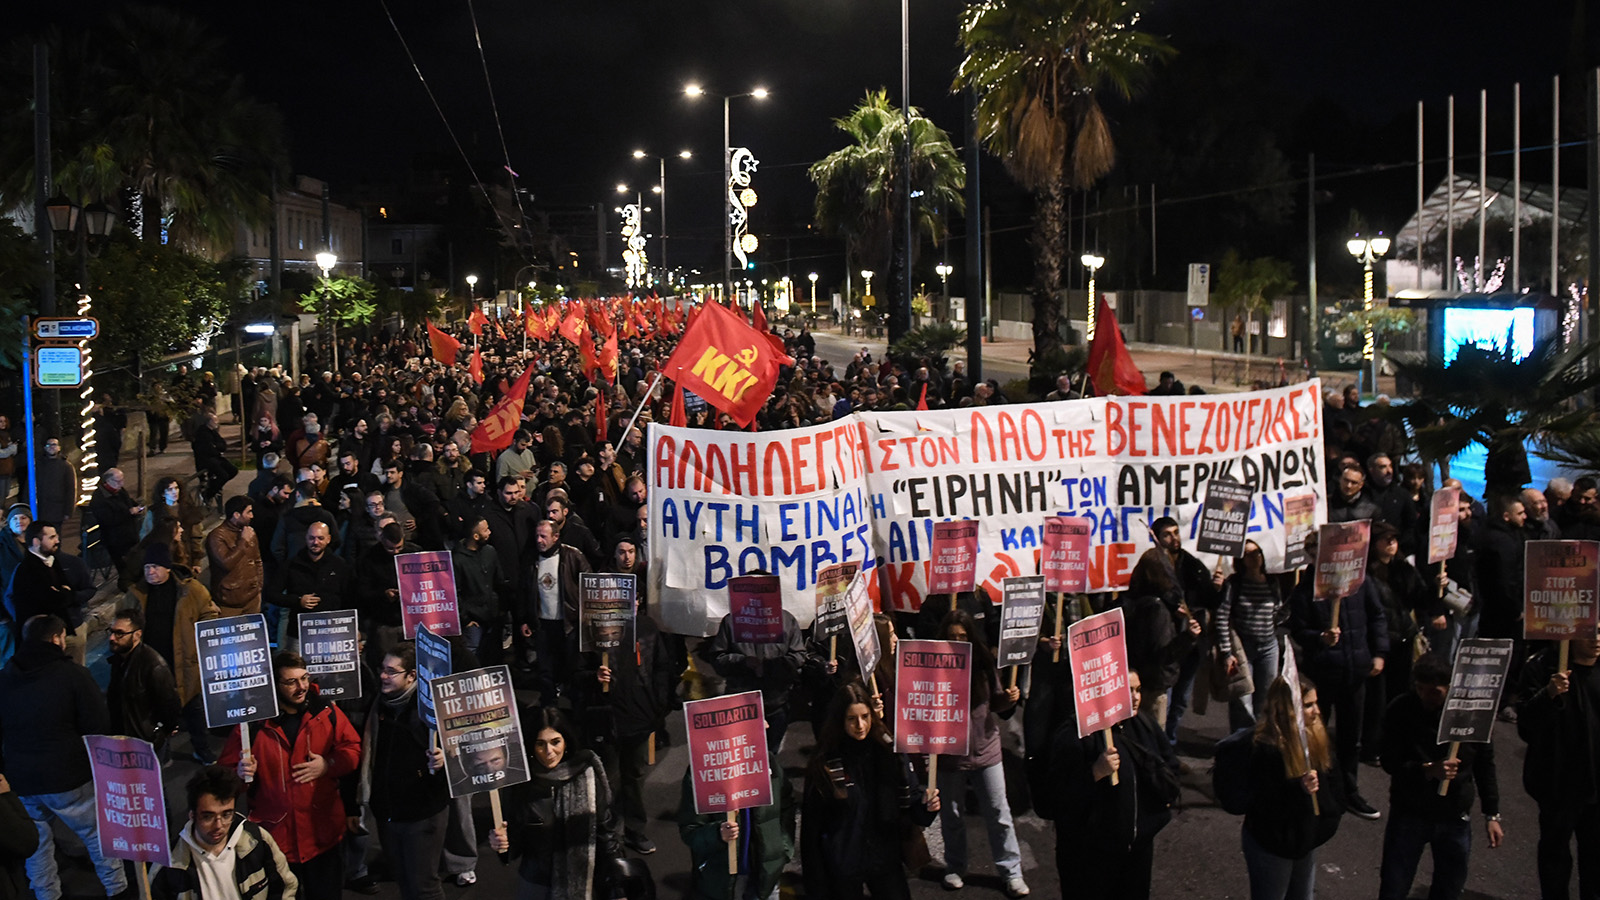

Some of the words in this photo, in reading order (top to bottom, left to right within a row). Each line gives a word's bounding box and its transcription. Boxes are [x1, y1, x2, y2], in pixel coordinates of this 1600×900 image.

[656, 421, 874, 496] ΑΛΛΗΛΕΓΓΥΗ
[878, 435, 960, 471] ΣΤΟΝ
[971, 409, 1047, 463] ΛΑΟ
[1052, 428, 1097, 459] ΤΗΣ
[1105, 384, 1319, 457] ΒΕΝΕΖΟΥΕΛΑΣ!
[662, 497, 760, 544] ΑΥΤΗ
[779, 487, 863, 542] ΕΙΝΑΙ
[871, 493, 886, 519] Η
[419, 580, 434, 591] ΣΤΟ
[584, 578, 597, 588] ΤΙΣ
[600, 578, 632, 589] ΒΟΜΒΕΣ
[411, 592, 428, 603] ΛΑΟ
[430, 590, 446, 601] ΤΗΣ
[586, 589, 600, 600] ΤΙΣ
[602, 589, 630, 600] ΡΙΧΝΕΙ
[1530, 590, 1593, 604] ΦΟΝΙΑΔΕΣ
[1073, 622, 1120, 650] SOLIDARITY
[304, 643, 315, 655] ΟΙ
[316, 639, 355, 653] ΒΟΜΒΕΣ
[205, 656, 218, 670] ΟΙ
[220, 648, 266, 668] ΒΟΜΒΕΣ
[311, 655, 322, 664] ΣΤΟ
[323, 652, 351, 663] ΚΑΡΑΚΑΣ
[904, 652, 965, 669] SOLIDARITY
[1082, 657, 1102, 671] WITH
[214, 671, 229, 681] ΣΤΟ
[229, 665, 262, 680] ΚΑΡΑΚΑΣ
[1080, 665, 1110, 688] PEOPLE
[1109, 661, 1119, 676] OF
[319, 687, 336, 696] ΚΝΕ
[436, 681, 456, 699] ΤΙΣ
[458, 671, 506, 694] ΒΟΜΒΕΣ
[912, 681, 935, 691] WITH
[937, 682, 952, 692] THE
[1078, 674, 1125, 704] VENEZUELA!
[443, 698, 463, 715] ΤΙΣ
[465, 688, 505, 711] ΡΙΧΝΕΙ
[907, 692, 944, 707] PEOPLE
[946, 694, 959, 707] OF
[226, 707, 247, 718] ΚΝΕ
[694, 704, 758, 729] SOLIDARITY
[902, 708, 964, 722] VENEZUELA!
[706, 739, 730, 751] WITH
[732, 734, 748, 747] THE
[929, 736, 947, 744] ΚΝΕ
[703, 748, 741, 767] PEOPLE
[743, 745, 756, 759] OF
[699, 760, 763, 782] VENEZUELA!
[471, 773, 495, 785] ΚΝΕ
[107, 781, 127, 794] WITH
[130, 783, 147, 794] THE
[731, 789, 750, 801] ΚΝΕ
[105, 793, 142, 811] PEOPLE
[143, 797, 155, 811] OF
[104, 808, 162, 830] VENEZUELA!
[132, 843, 153, 852] ΚΝΕ
